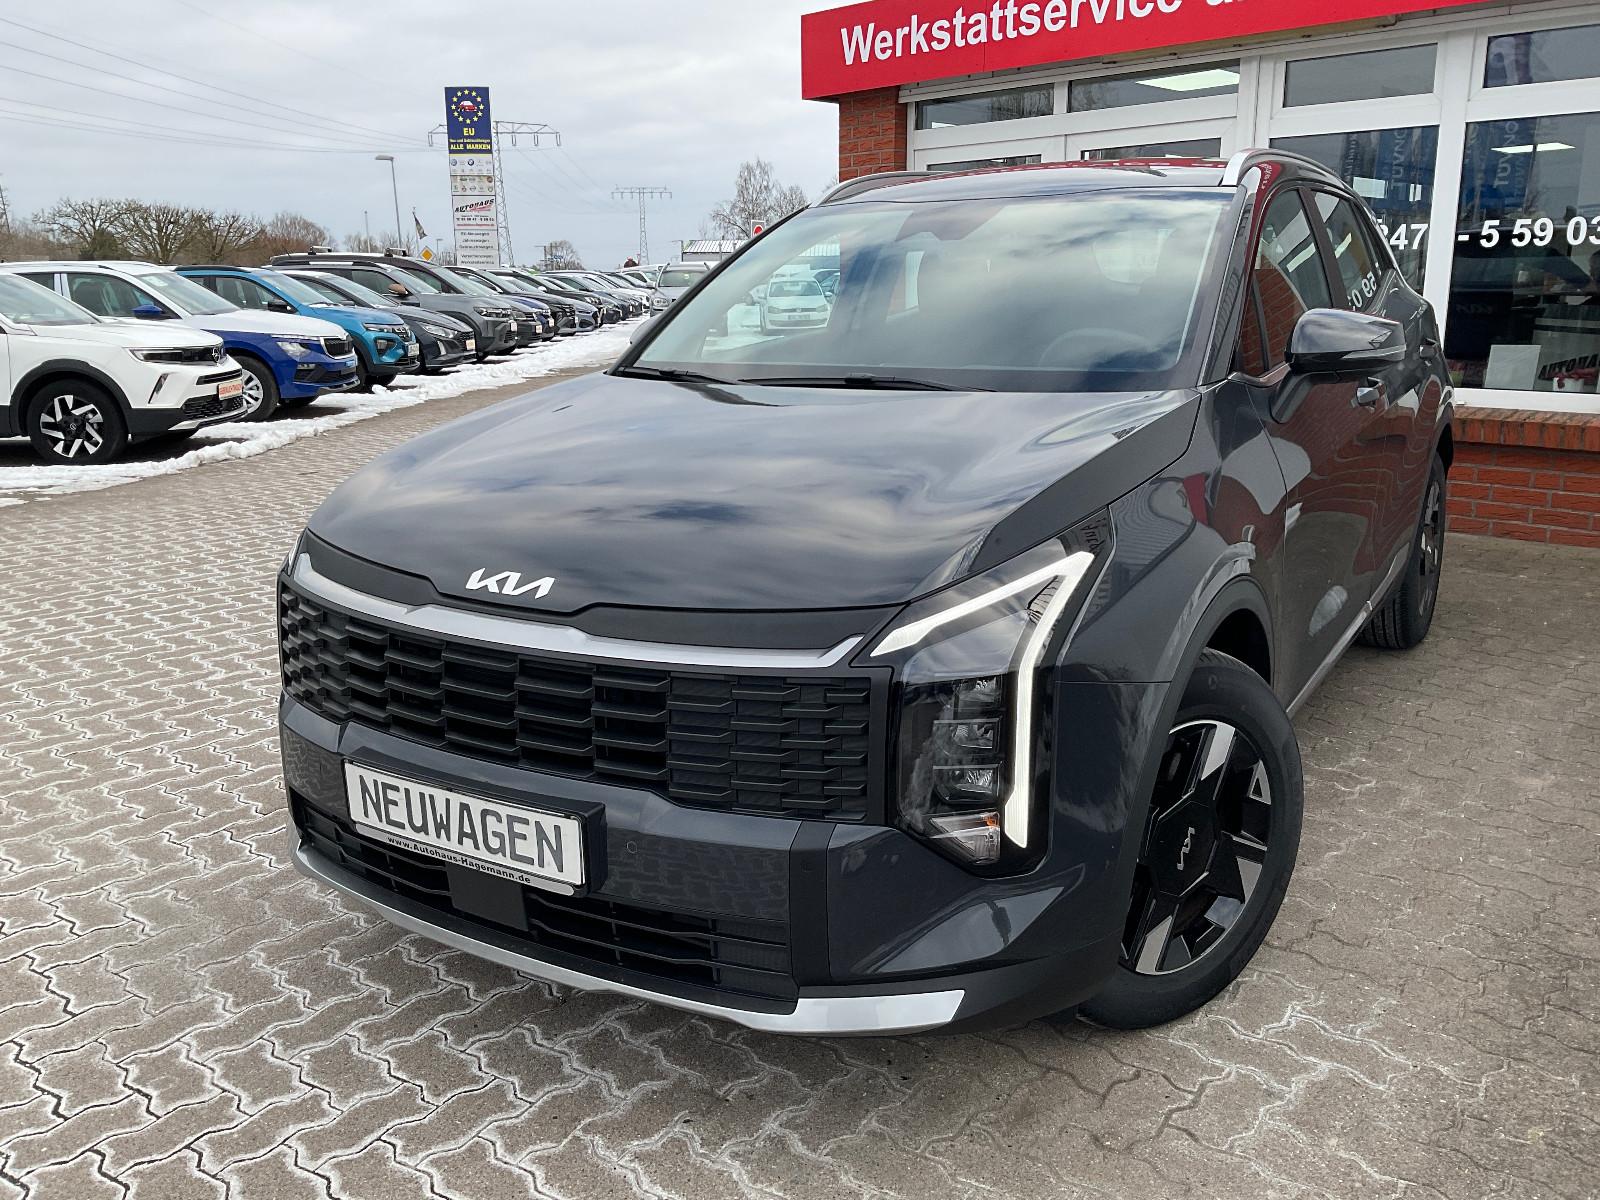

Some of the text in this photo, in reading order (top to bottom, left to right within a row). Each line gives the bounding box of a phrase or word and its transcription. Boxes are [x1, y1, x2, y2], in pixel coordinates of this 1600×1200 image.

[463, 127, 476, 136] EU
[454, 198, 495, 213] AUTOHAUS
[1479, 219, 1500, 248] 5
[1511, 217, 1554, 247] 59
[1566, 216, 1600, 246] 03
[1538, 353, 1600, 381] AUTOHA
[358, 774, 565, 874] NEUWAGEN
[387, 836, 531, 884] www.Autohaus-Hagemann.de
